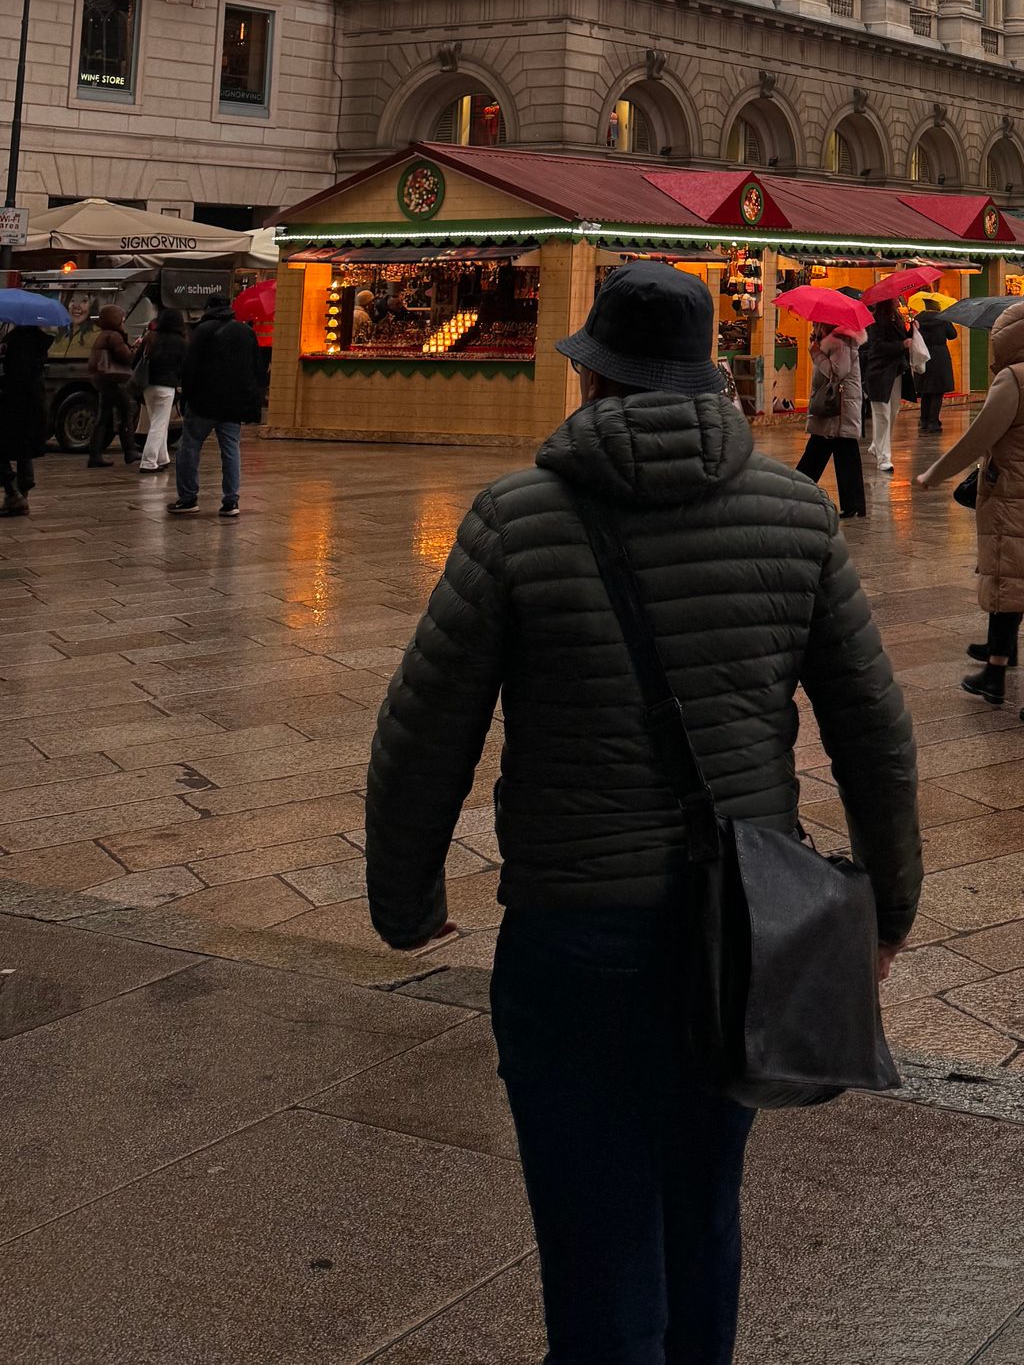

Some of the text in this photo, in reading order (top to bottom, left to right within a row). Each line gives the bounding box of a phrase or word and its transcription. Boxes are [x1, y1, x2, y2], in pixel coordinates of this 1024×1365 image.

[80, 73, 125, 85] WINE STORE
[120, 236, 197, 250] SIGNORVINO
